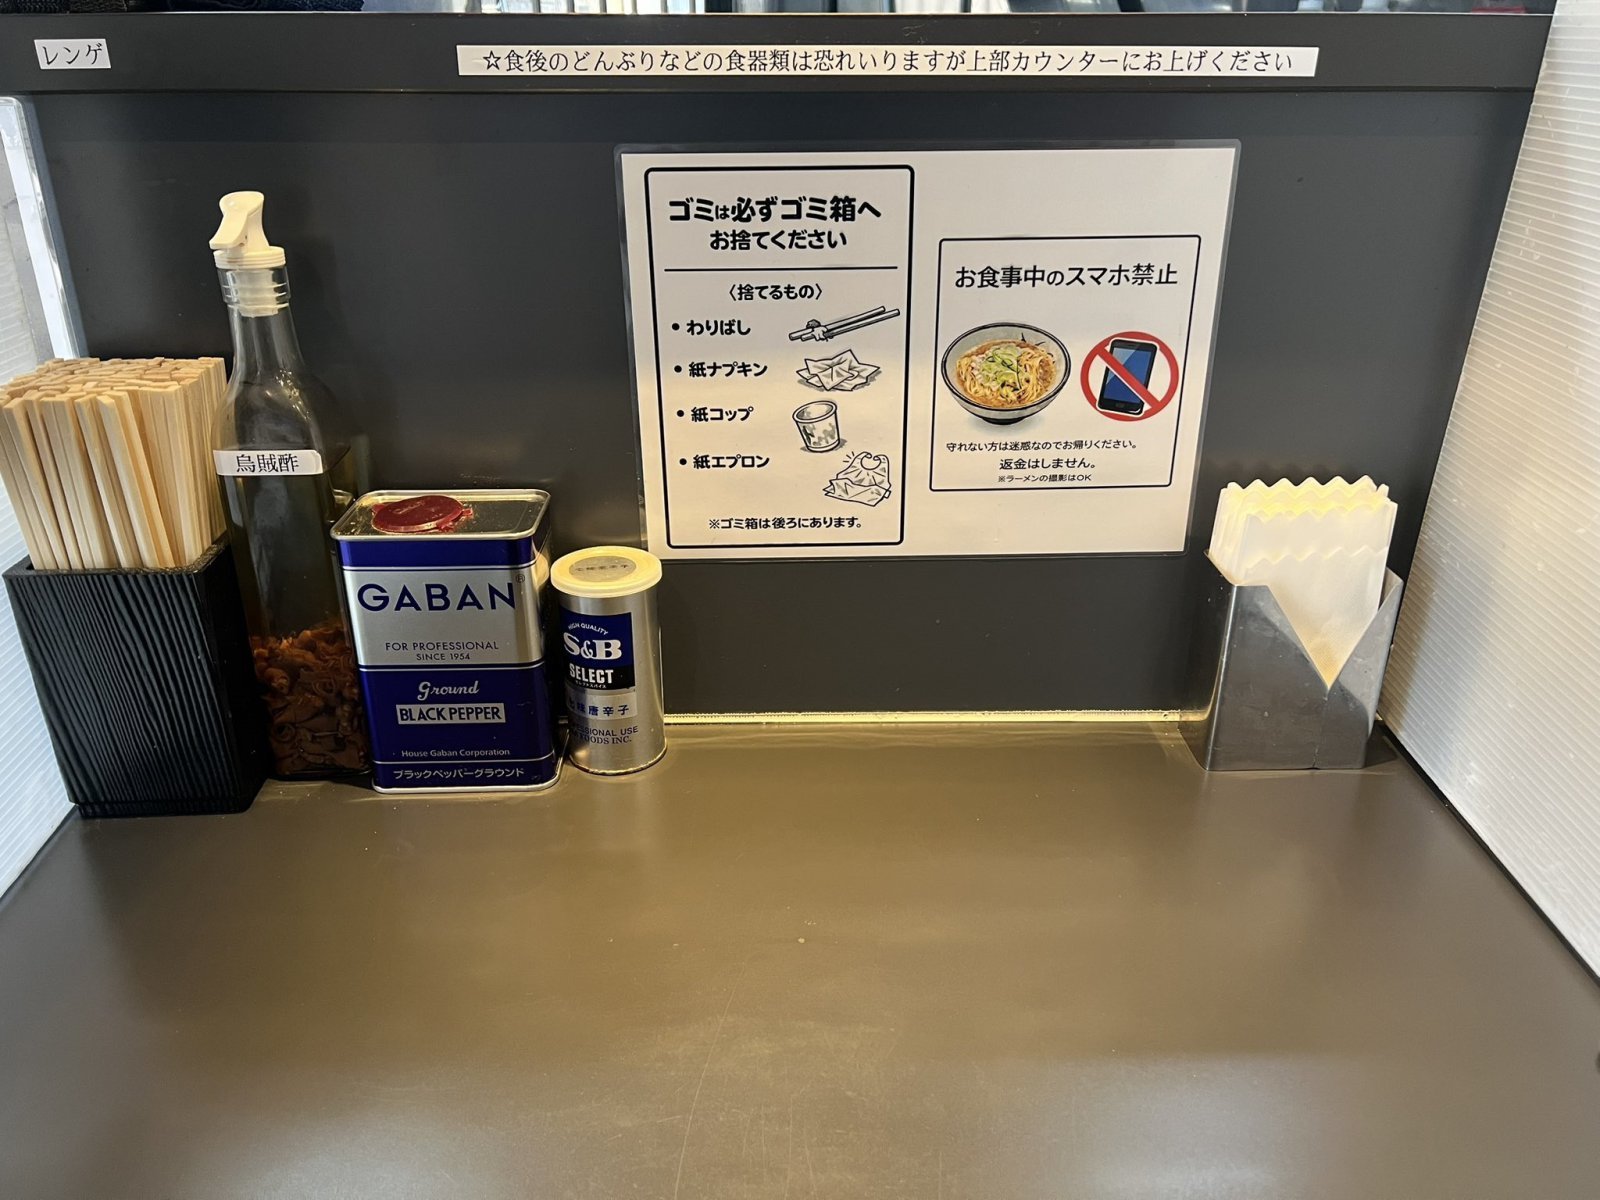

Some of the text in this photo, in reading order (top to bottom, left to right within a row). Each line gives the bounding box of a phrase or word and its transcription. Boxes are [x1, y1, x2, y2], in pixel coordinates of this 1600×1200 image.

[42, 43, 103, 65] レンゲ
[669, 195, 882, 223] ゴミは必ずゴミ箱へ
[709, 229, 847, 250] お捨てください
[955, 263, 1178, 288] お食事中のスマホ禁止
[686, 319, 751, 336] わりばし
[688, 361, 768, 378] 紙ナプキン
[690, 406, 754, 422] 紙コップ
[946, 440, 1137, 453] 守れない方は迷惑なのでお帰りください。
[236, 453, 300, 473] 烏賊酢
[693, 454, 770, 469] 紙エプロン
[999, 457, 1096, 470] 返金はしません。
[708, 516, 862, 530] ※ゴミ箱は後ろにあります。
[357, 582, 516, 612] GABAN
[580, 622, 609, 636] QUALITY
[385, 641, 499, 651] FOR PROFESSIONAL
[563, 632, 622, 660] S&B
[416, 652, 470, 661] SINCE 1954
[569, 662, 614, 684] SELECT
[417, 680, 480, 701] Ground
[400, 706, 502, 721] BLACK PEPPER
[620, 725, 639, 736] USE
[612, 735, 632, 745] INC.
[429, 749, 458, 757] Gaban
[459, 748, 511, 758] Corporation
[393, 767, 525, 779] ブラックペッパーグラウンド
